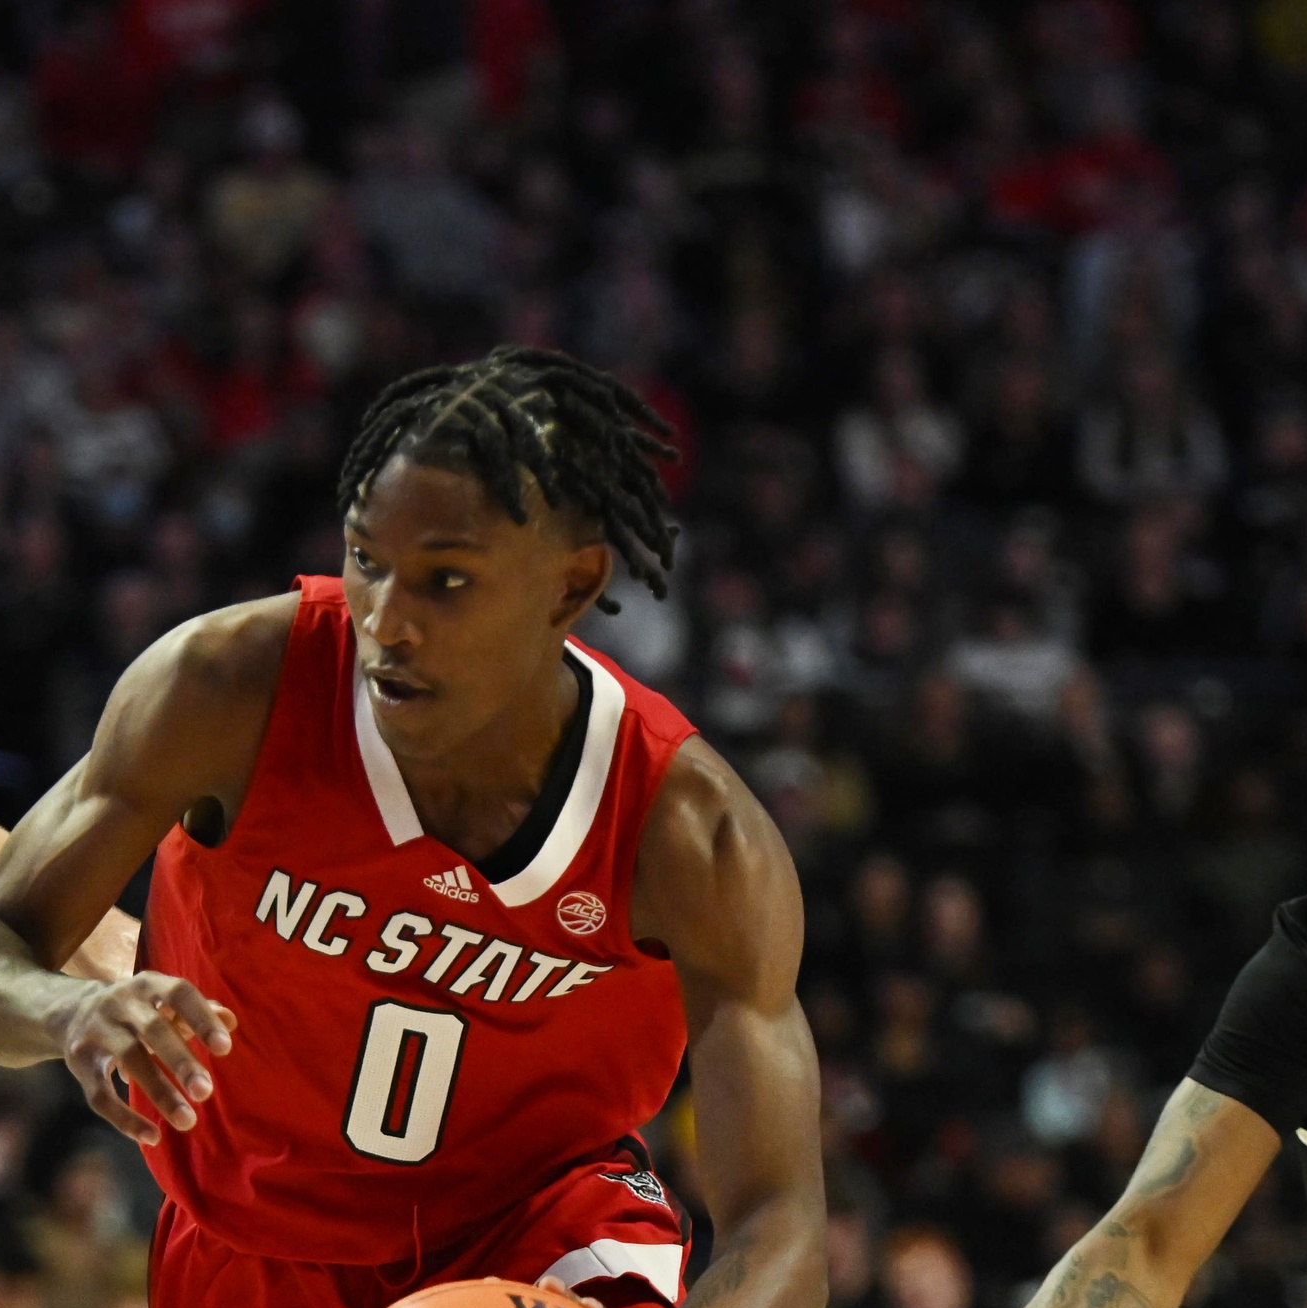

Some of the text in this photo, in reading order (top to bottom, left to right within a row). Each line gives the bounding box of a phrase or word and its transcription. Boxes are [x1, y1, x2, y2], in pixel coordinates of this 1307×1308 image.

[423, 876, 480, 903] adidas
[563, 902, 604, 921] ACC
[254, 869, 615, 1003] NC STATE
[342, 998, 470, 1166] 0
